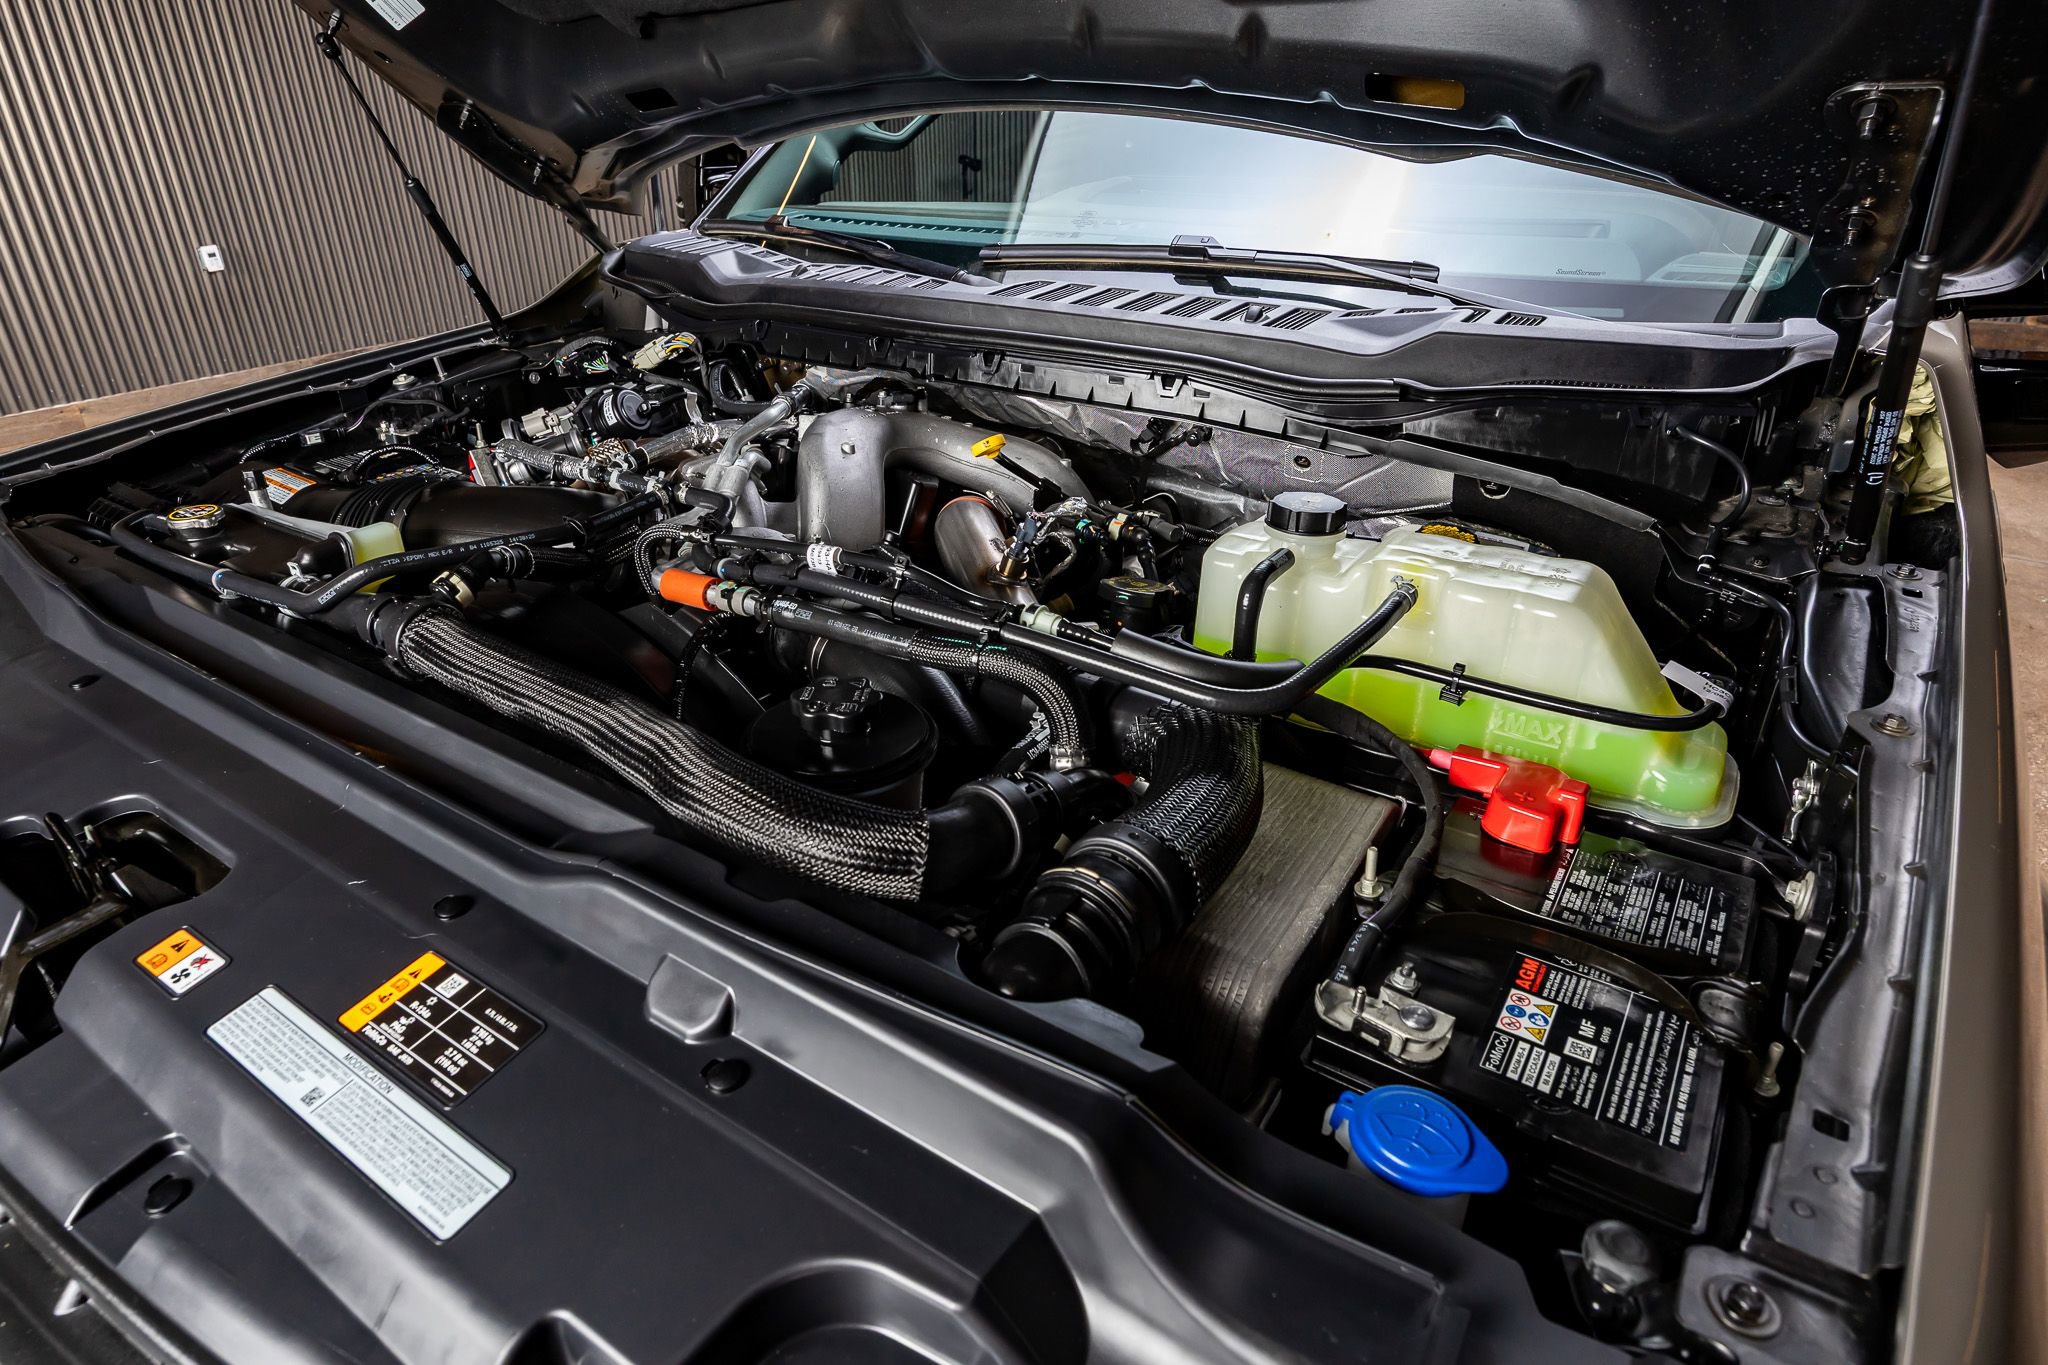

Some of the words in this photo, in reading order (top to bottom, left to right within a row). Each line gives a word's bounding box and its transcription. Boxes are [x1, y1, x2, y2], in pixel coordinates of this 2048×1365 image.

[1504, 712, 1565, 744] MAX
[1514, 957, 1539, 990] AGM
[407, 1000, 434, 1019] R-134a
[360, 1024, 390, 1047] FoMoCo
[1578, 1017, 1597, 1039] MF
[1485, 1033, 1509, 1071] FoMoCo
[1528, 1048, 1542, 1075] CCA/SAE
[340, 1052, 395, 1095] MODIFICATION
